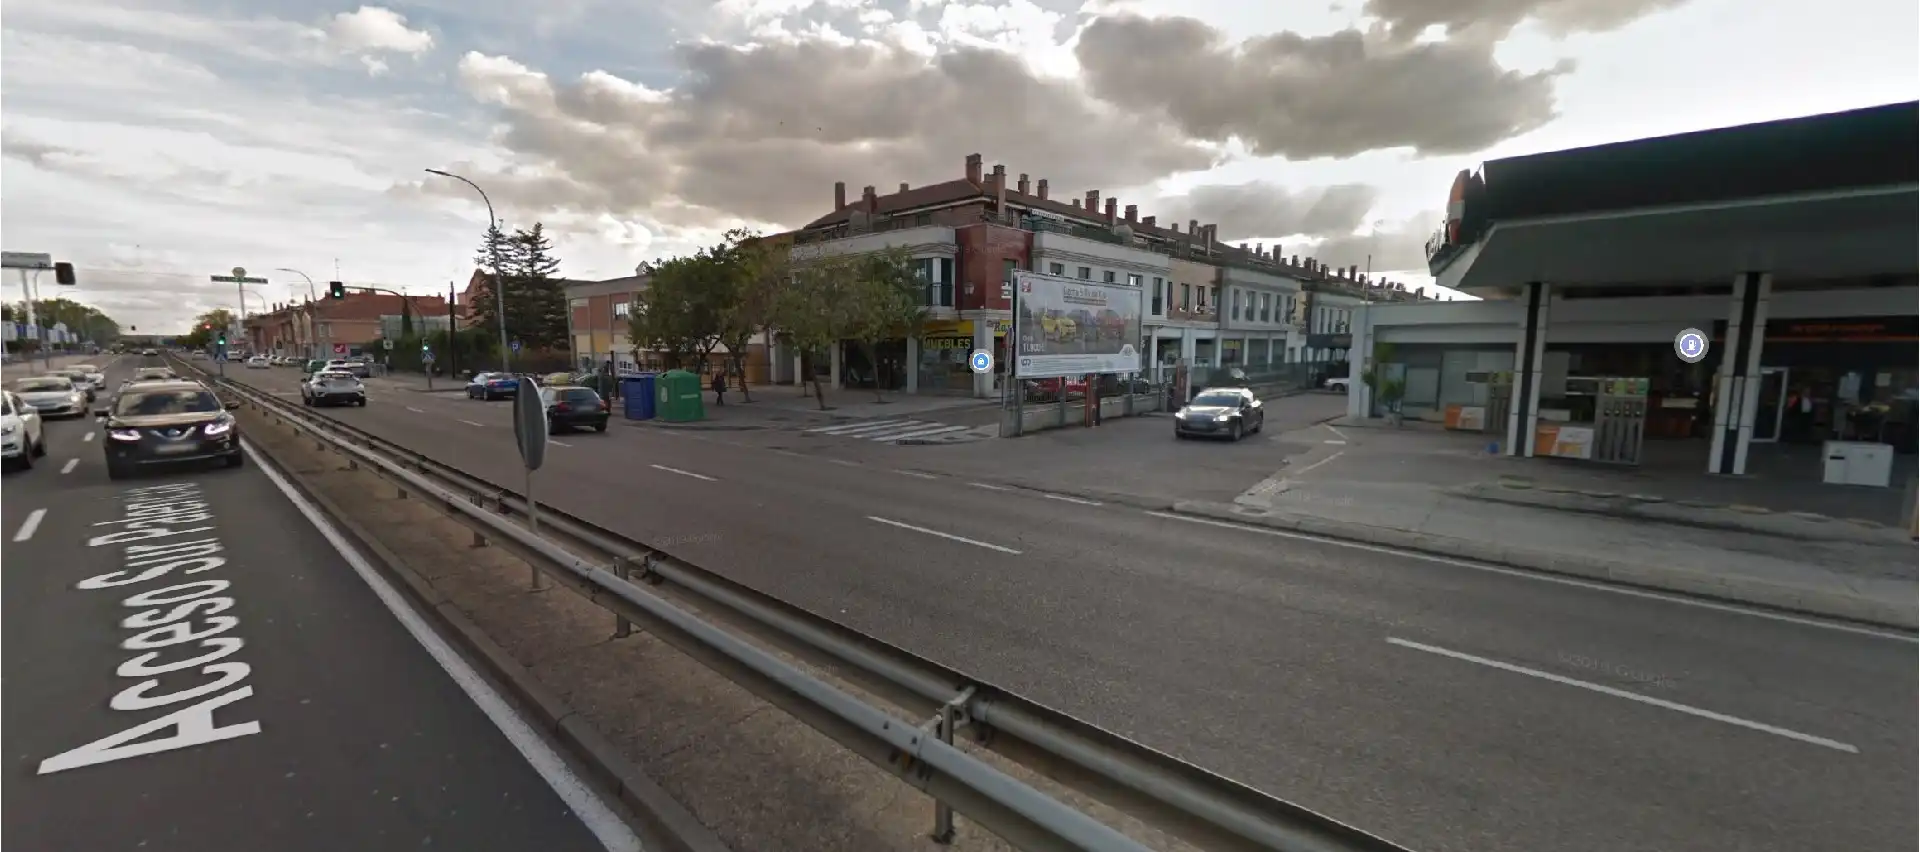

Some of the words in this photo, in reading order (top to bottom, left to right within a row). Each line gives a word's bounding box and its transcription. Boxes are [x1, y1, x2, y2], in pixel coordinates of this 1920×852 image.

[923, 338, 971, 350] MUEBLES
[87, 482, 216, 547] Palencia
[76, 537, 228, 591] Sur
[37, 579, 261, 776] Acceso
